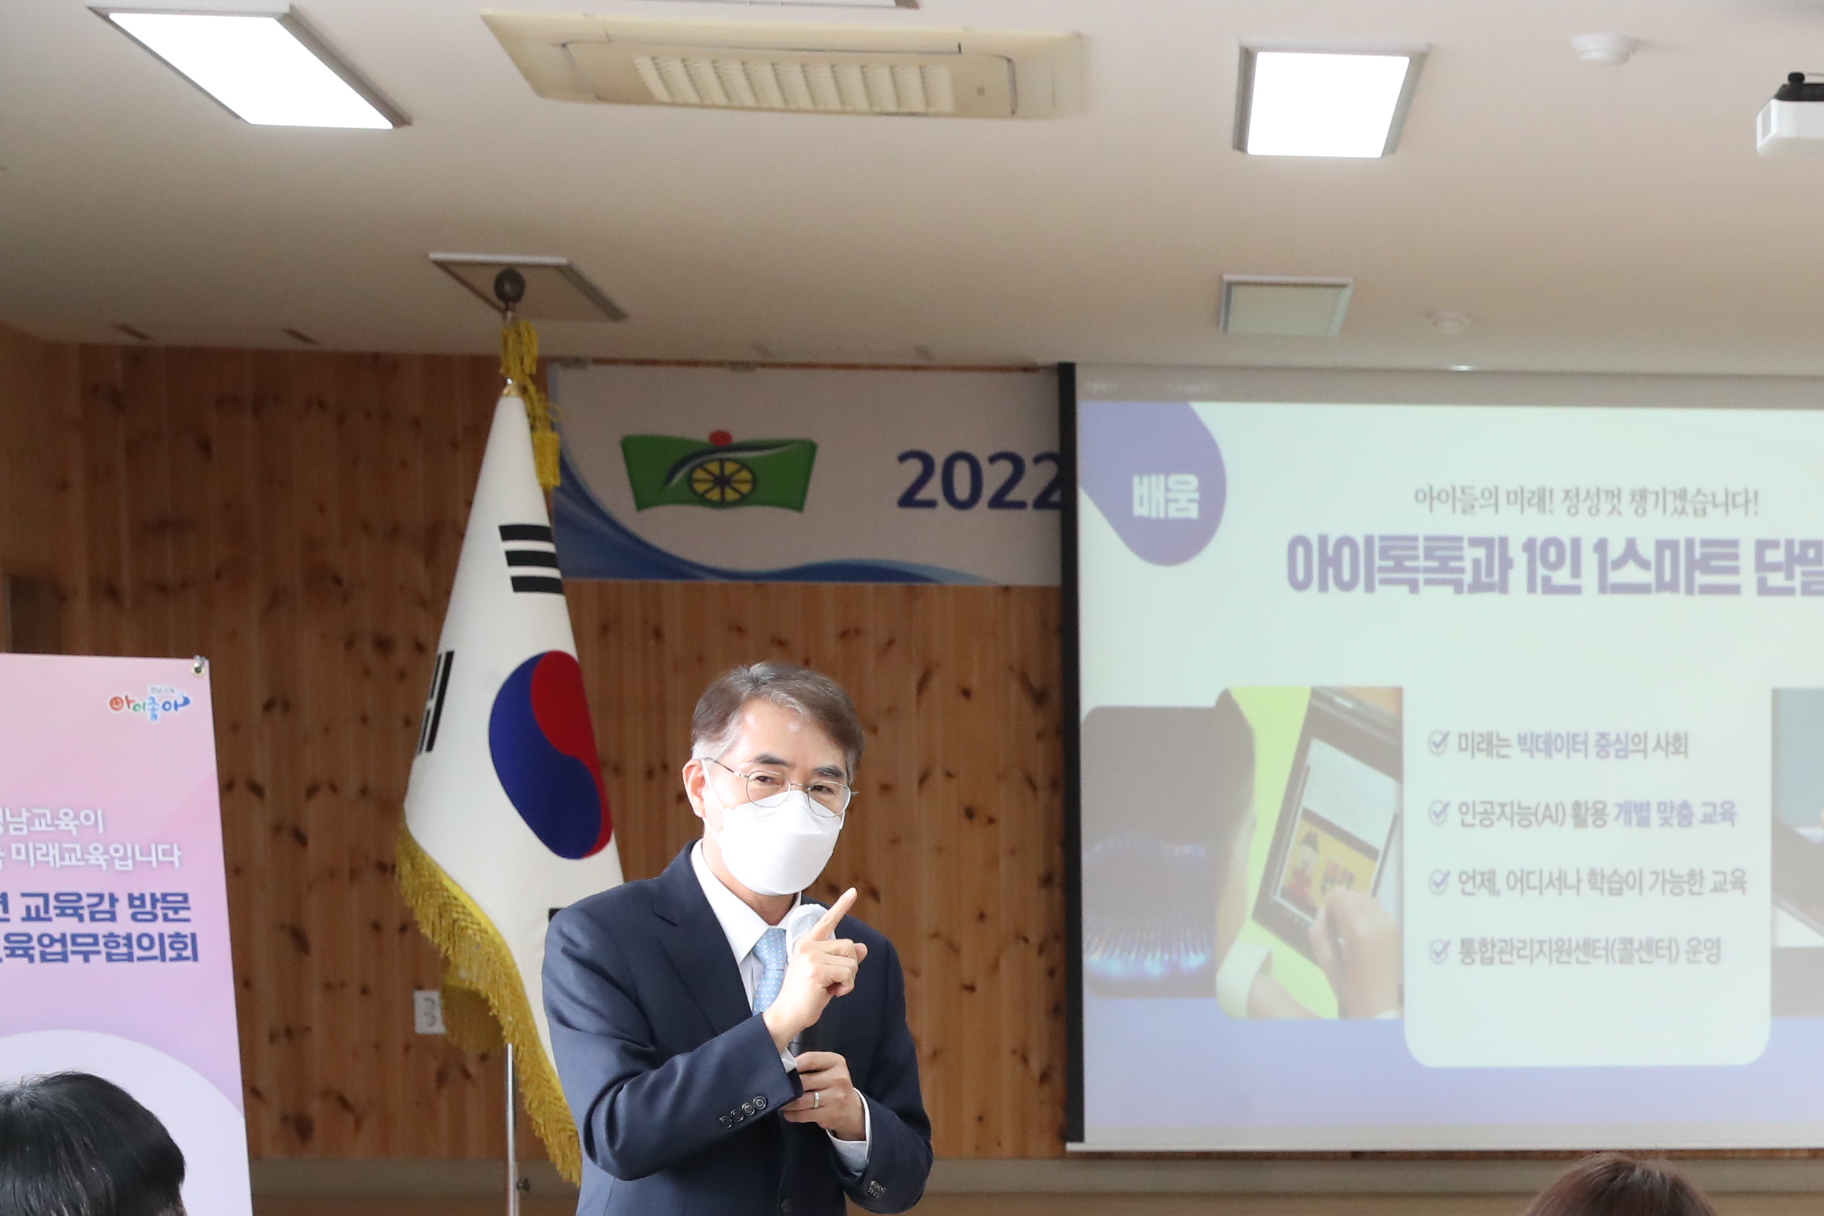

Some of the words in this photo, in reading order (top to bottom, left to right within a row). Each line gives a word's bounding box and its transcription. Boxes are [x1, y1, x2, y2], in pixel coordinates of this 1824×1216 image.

[898, 450, 1062, 510] 2022
[1133, 474, 1199, 520] 배움
[1414, 484, 1499, 516] 아이들의
[1505, 486, 1554, 516] 미래!
[1561, 486, 1624, 518] 정성껏
[1628, 486, 1760, 518] 챙기겠습니다!
[1286, 534, 1514, 595] 아이톡톡과
[1522, 536, 1583, 596] 1인
[1592, 536, 1741, 597] 1스마트
[1458, 731, 1512, 760] 미래는
[1517, 730, 1589, 760] 빅데이터
[1594, 731, 1648, 760] 중심의
[1652, 731, 1689, 759] 사회
[0, 806, 104, 836] 남교육이
[1458, 800, 1566, 829] 인공지능(AI)
[1571, 800, 1609, 828] 활용
[1613, 800, 1652, 828] 개별
[1657, 800, 1694, 828] 맞춤
[1700, 800, 1737, 828] 교육
[10, 842, 183, 871] 미래교육입니다
[1458, 868, 1501, 896] 언제,
[1506, 868, 1582, 896] 어디서나
[1587, 868, 1643, 896] 학습이
[1649, 868, 1705, 896] 가능한
[1710, 868, 1747, 896] 교육
[20, 891, 119, 923] 교육감
[127, 892, 192, 923] 방문
[0, 931, 199, 964] 육업무협의회
[1458, 937, 1680, 966] 통합관리지원센터(콜센터)
[1684, 937, 1722, 965] 운영
